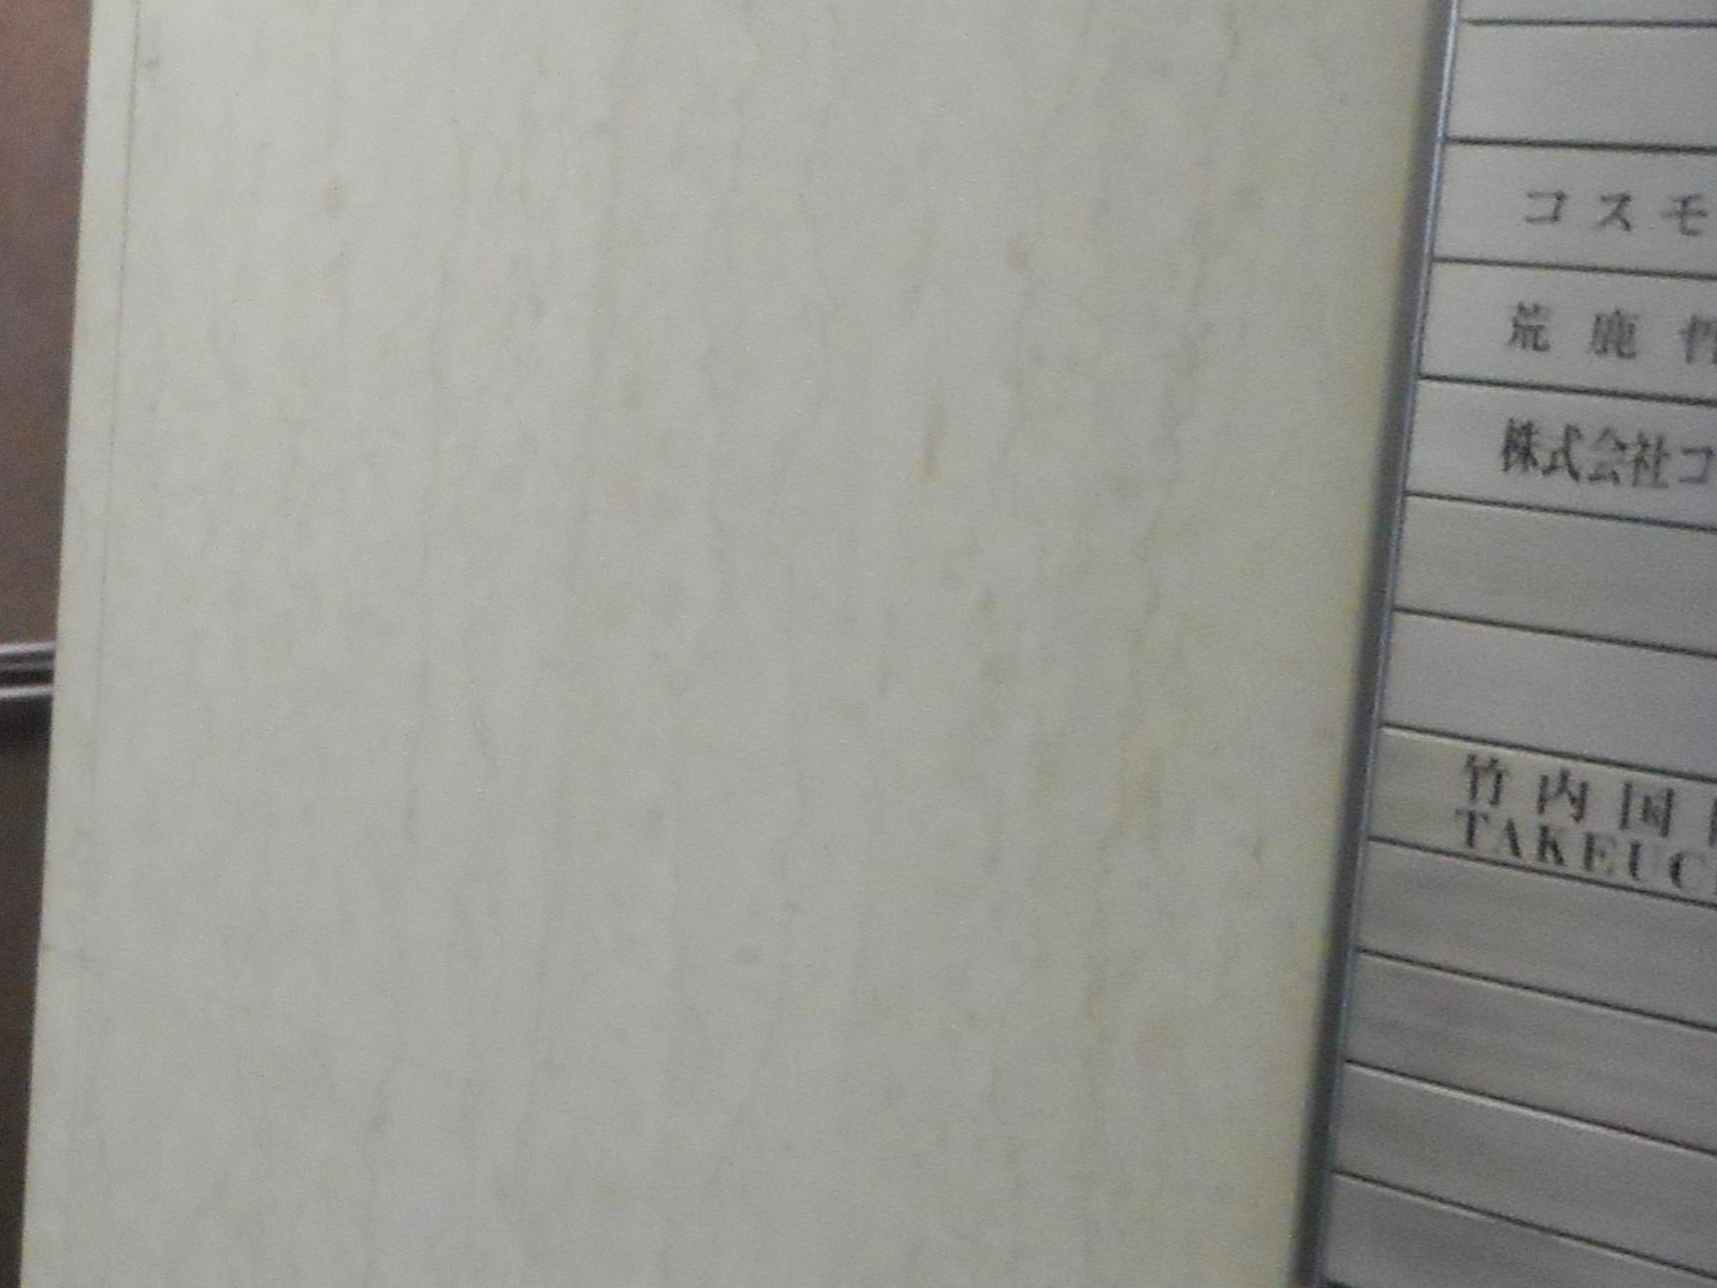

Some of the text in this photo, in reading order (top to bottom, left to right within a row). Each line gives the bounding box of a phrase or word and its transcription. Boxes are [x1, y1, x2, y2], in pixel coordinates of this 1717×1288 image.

[1525, 189, 1709, 237] コスモ
[1501, 417, 1717, 489] 株式会社コ
[1465, 753, 1717, 848] 竹内国
